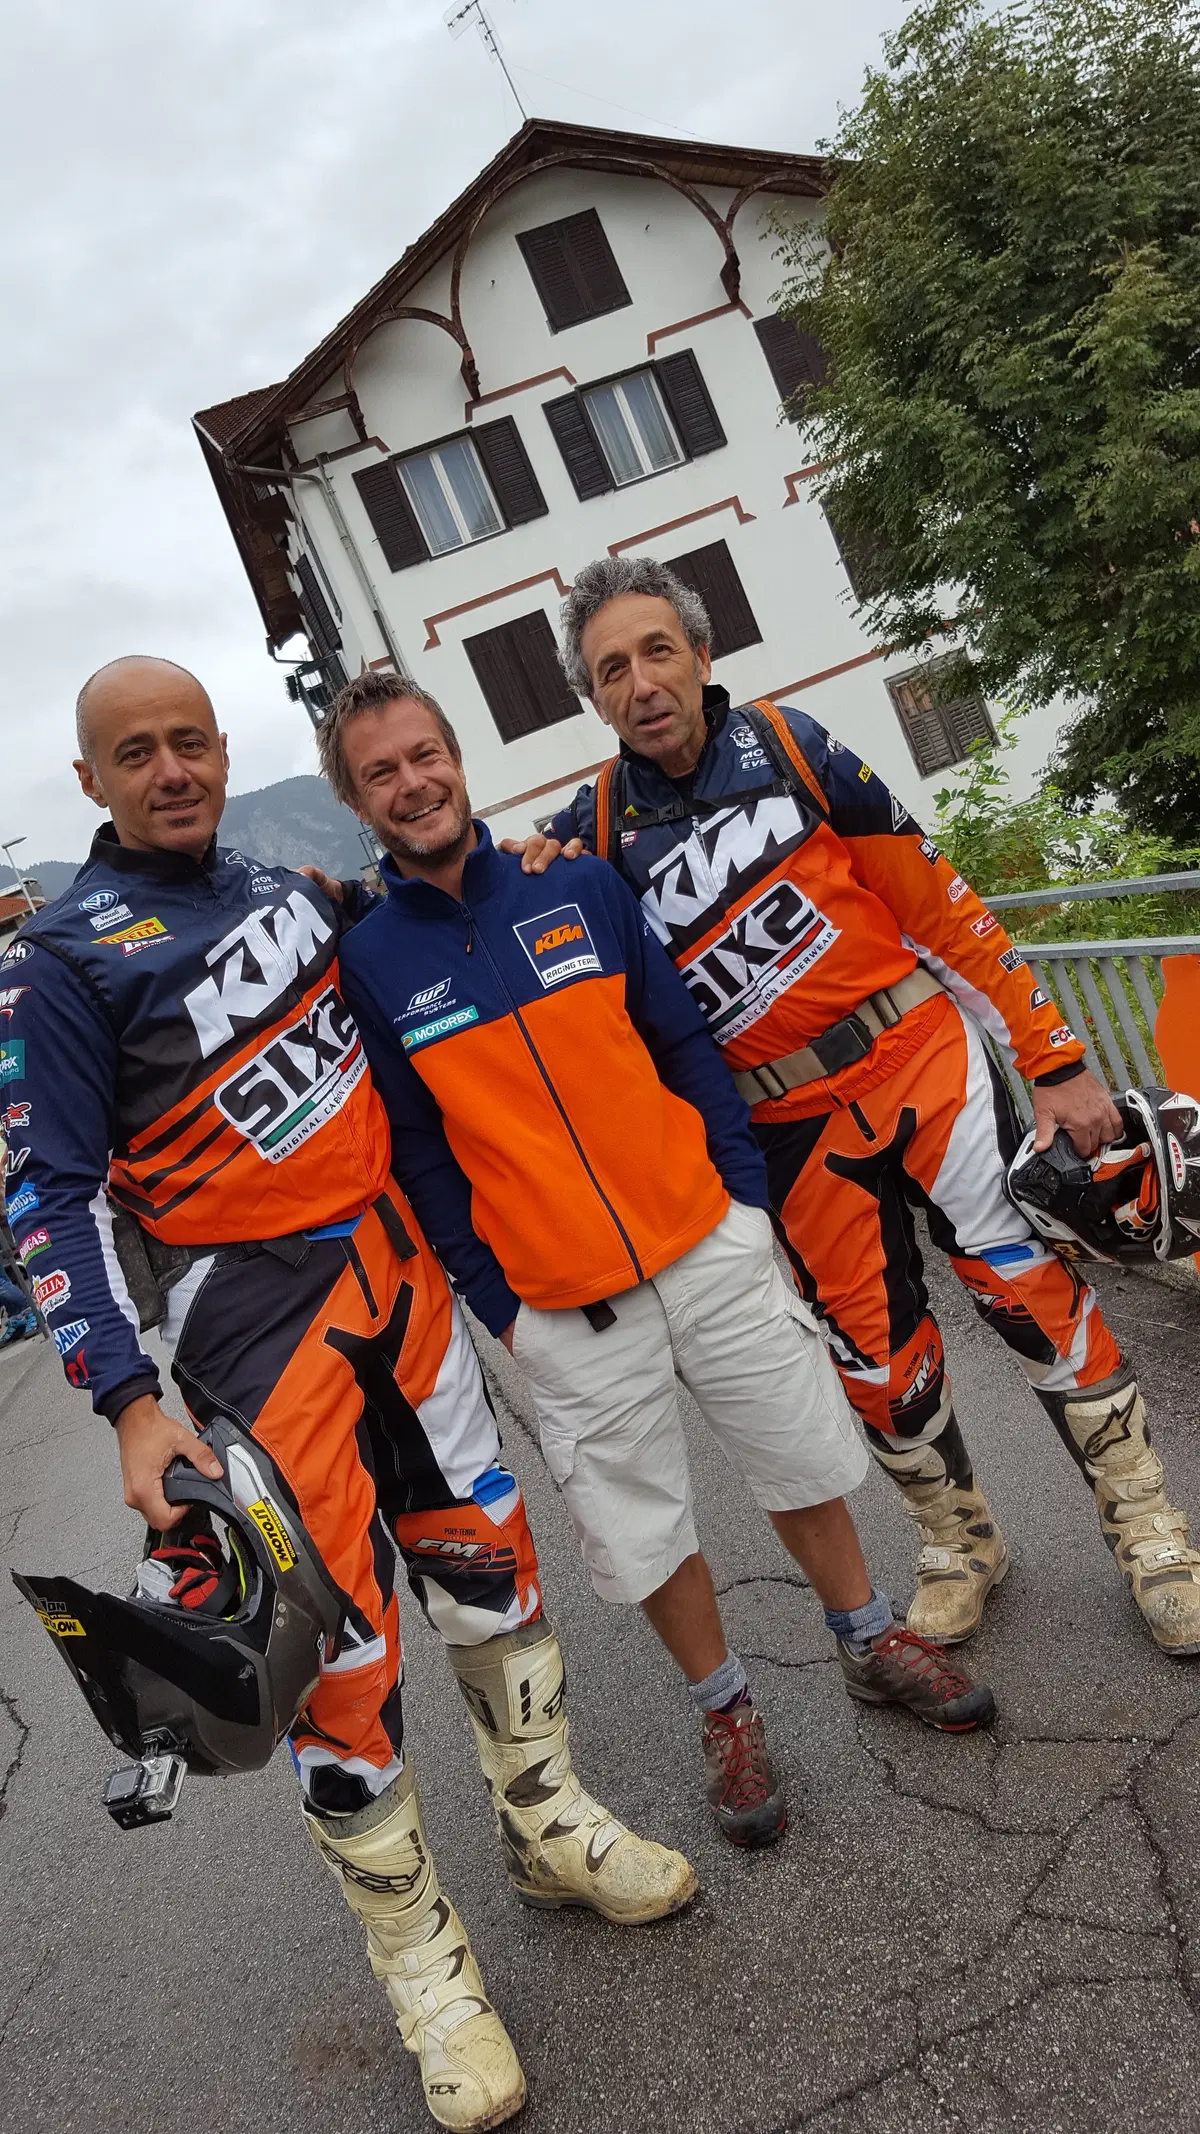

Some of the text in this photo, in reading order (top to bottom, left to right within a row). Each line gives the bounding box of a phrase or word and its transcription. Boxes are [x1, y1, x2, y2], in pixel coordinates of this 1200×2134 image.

[640, 796, 804, 946] KTM
[251, 883, 280, 893] VENTS
[95, 911, 133, 930] Commerciali
[99, 909, 120, 921] Veicoli
[535, 924, 584, 955] KTM
[184, 890, 333, 1060] KTM
[717, 1014, 754, 1043] ORIGINAL
[779, 931, 835, 987] UNDERWEAR
[393, 1001, 442, 1024] PERFORMANCE
[423, 998, 457, 1016] SYSTEMS
[414, 1011, 474, 1041] MOTOREX
[272, 1118, 323, 1160] ORIGINAL
[1171, 1142, 1183, 1182] BELL
[251, 1508, 290, 1562] MOTO.IT
